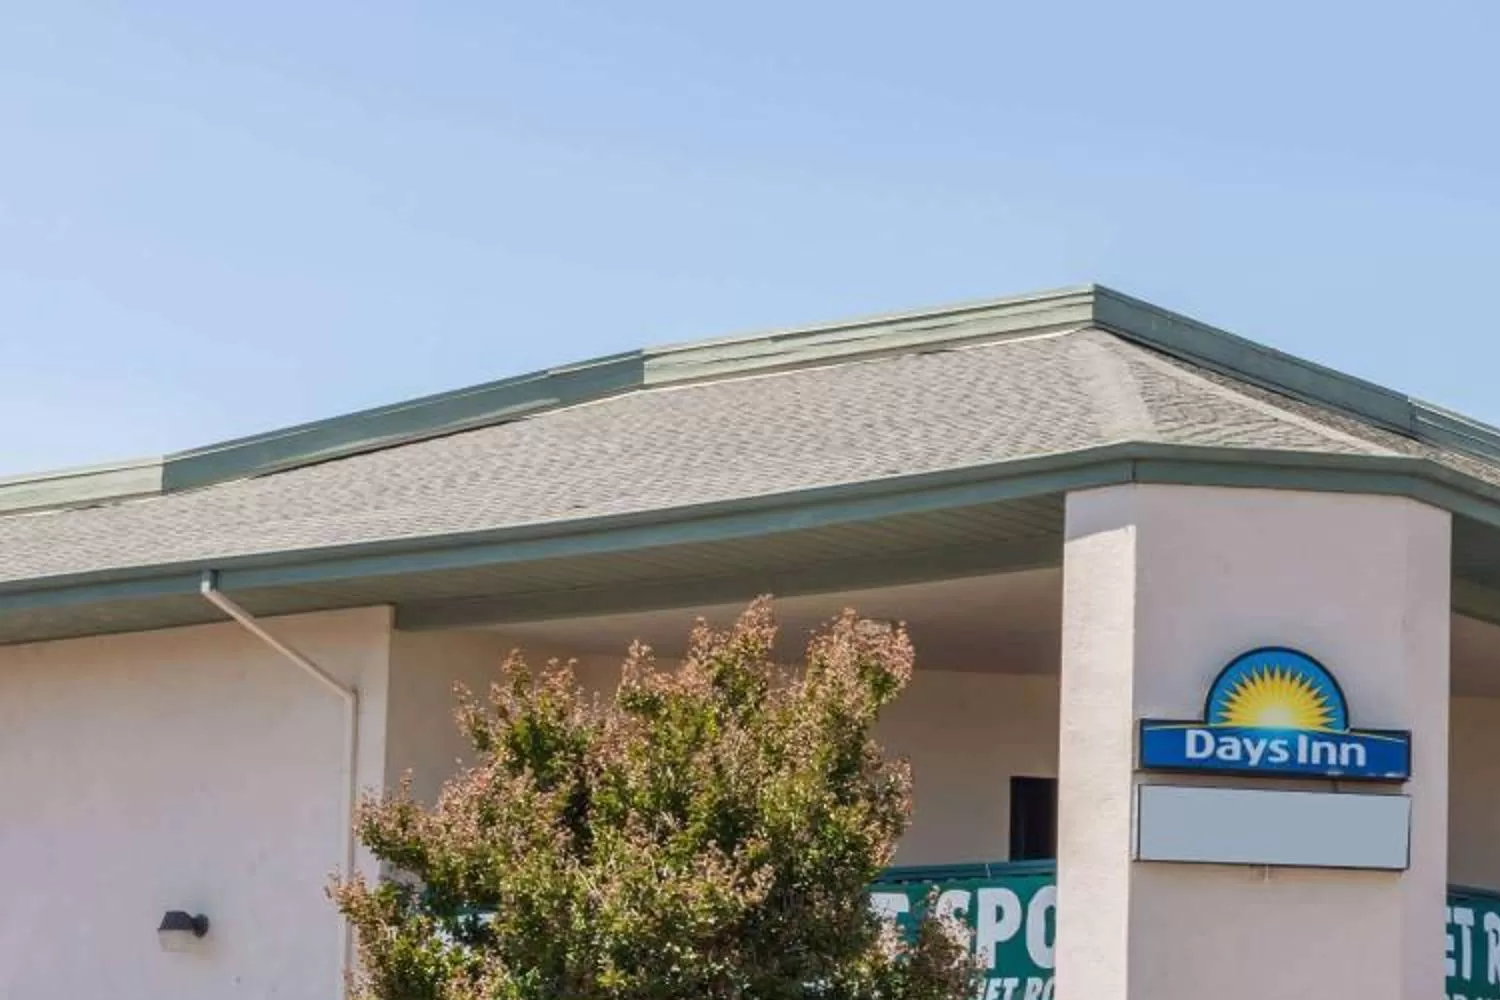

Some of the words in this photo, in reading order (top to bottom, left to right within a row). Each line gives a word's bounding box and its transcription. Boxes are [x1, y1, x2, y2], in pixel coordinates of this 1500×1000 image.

[1184, 729, 1290, 767] Days
[1297, 735, 1366, 766] Inn
[1445, 906, 1475, 982] ET
